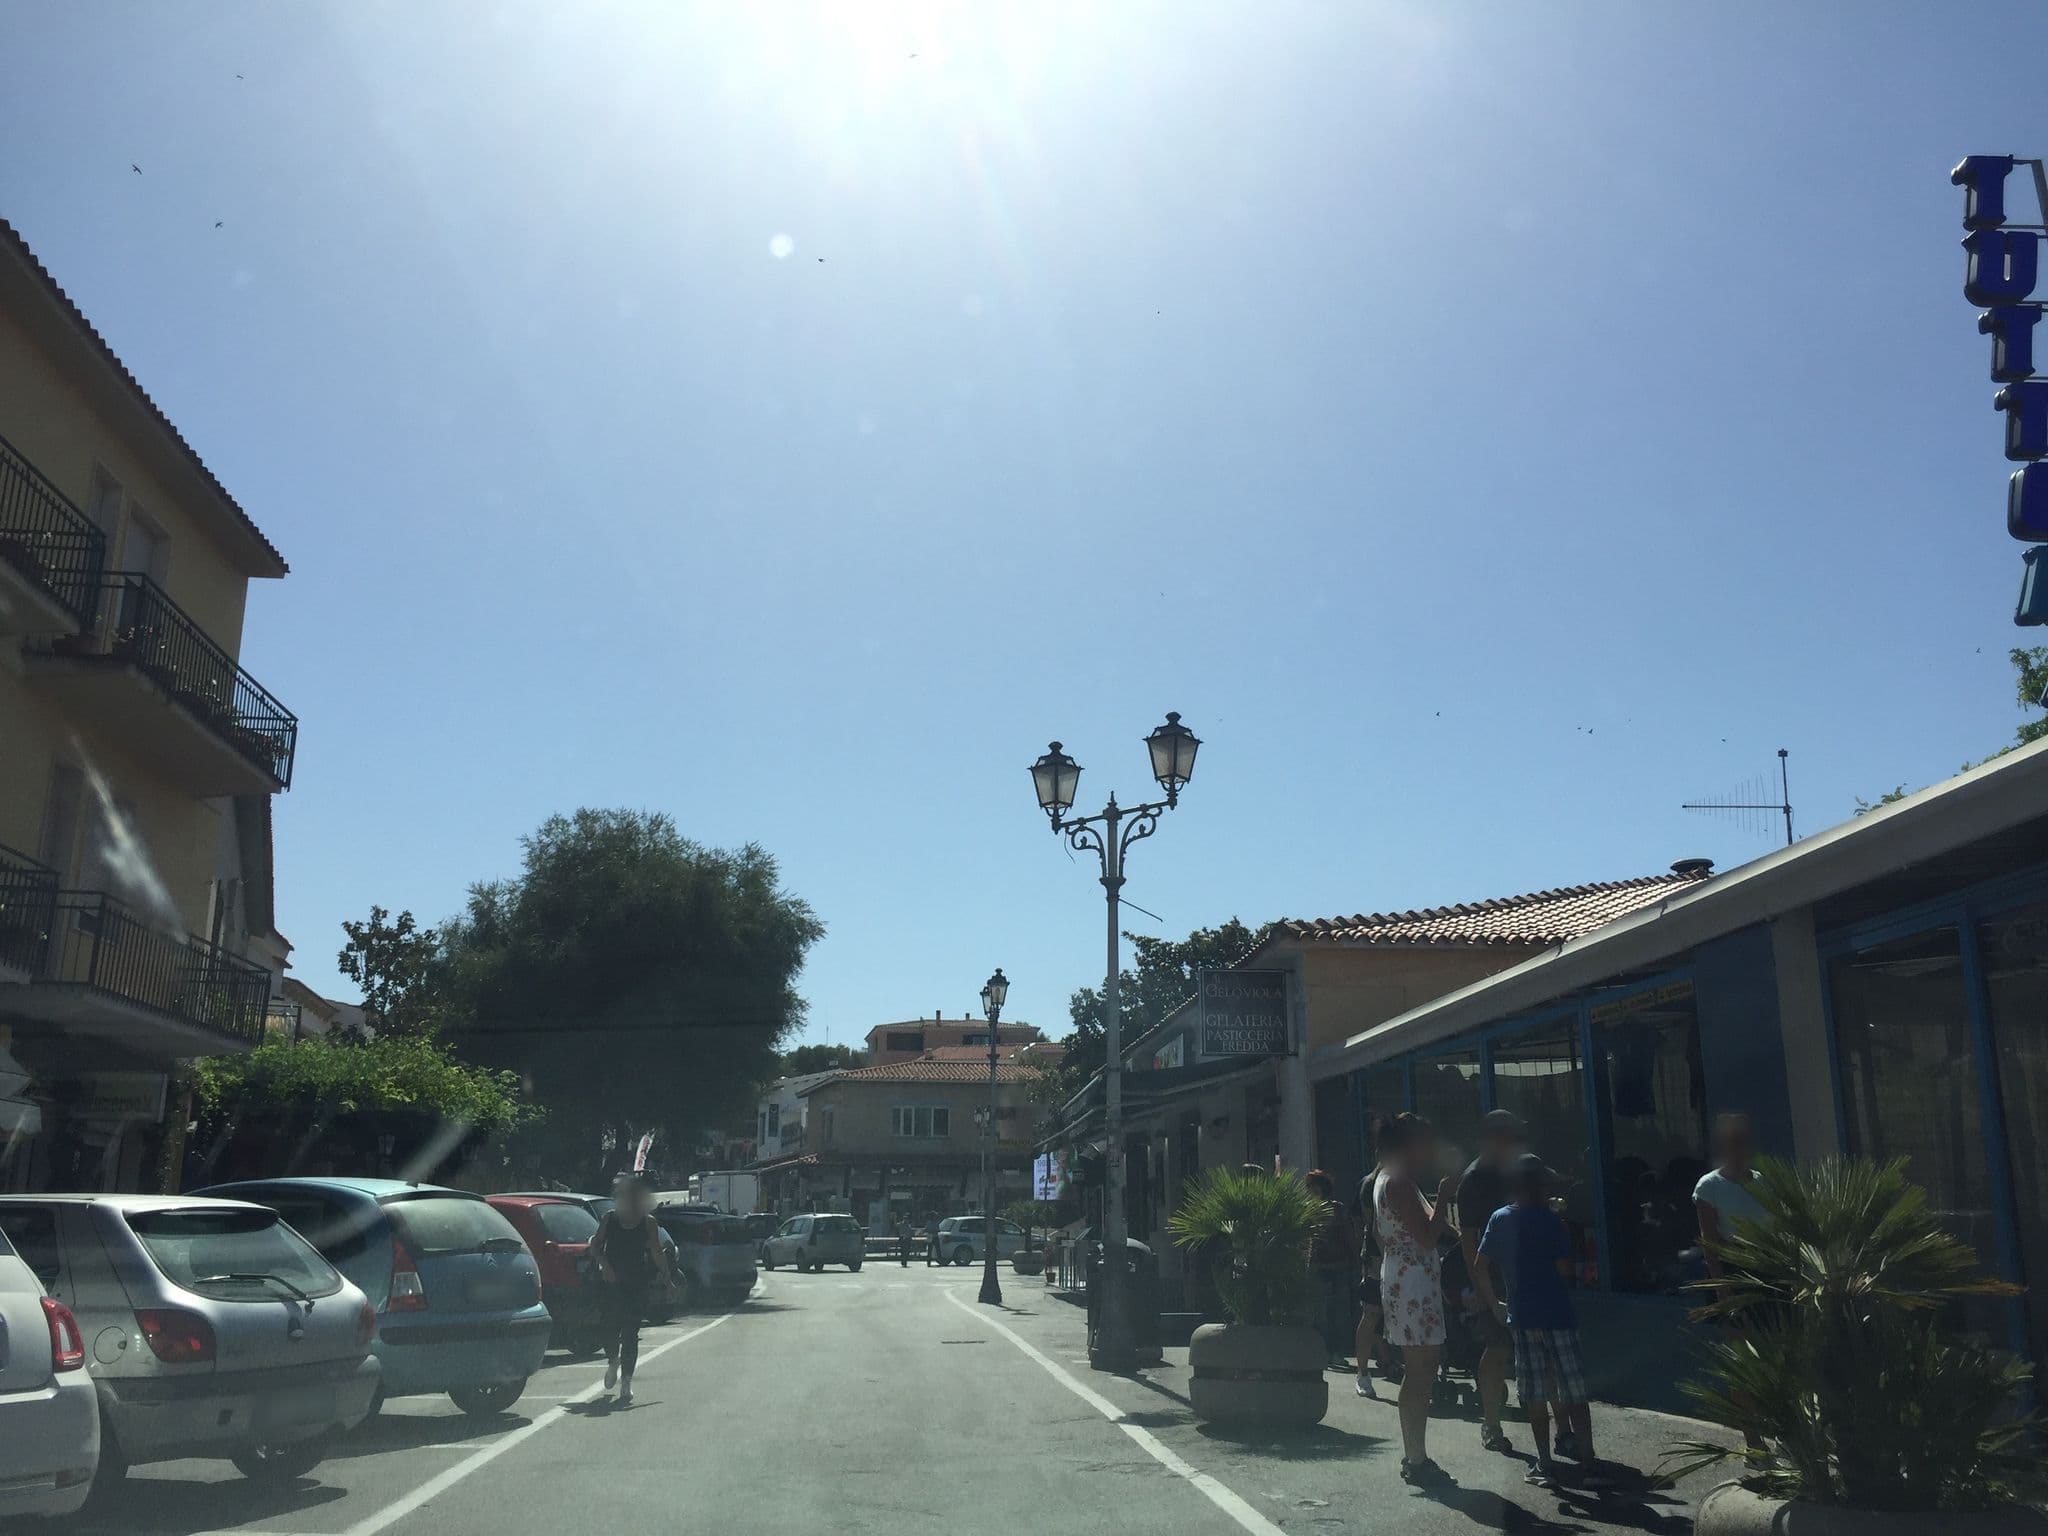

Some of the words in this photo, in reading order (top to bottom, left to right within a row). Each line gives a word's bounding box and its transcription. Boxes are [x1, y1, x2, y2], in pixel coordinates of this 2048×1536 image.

[1206, 1014, 1284, 1027] GELATERIA
[1206, 1029, 1284, 1041] PASTICCERIA
[1222, 1040, 1271, 1052] FREDDA
